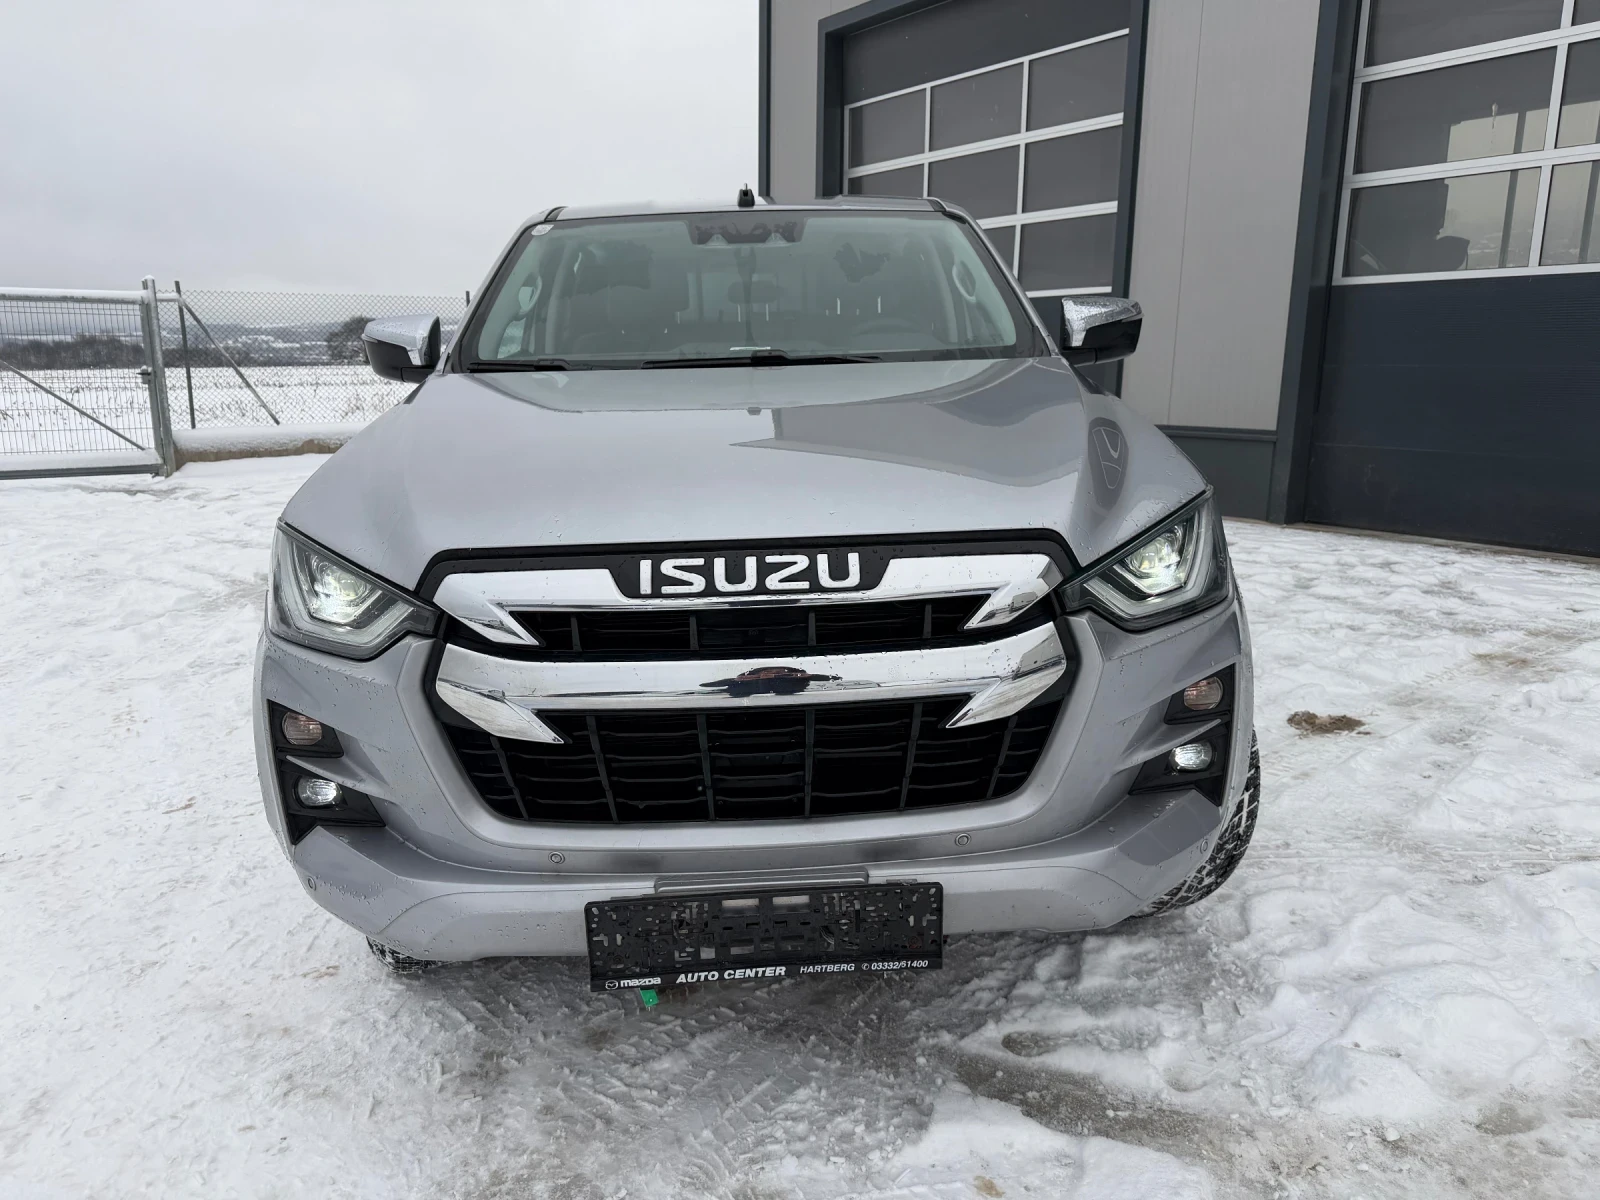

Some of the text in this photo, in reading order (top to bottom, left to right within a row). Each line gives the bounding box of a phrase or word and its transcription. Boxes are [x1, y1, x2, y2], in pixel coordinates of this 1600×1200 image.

[639, 552, 861, 595] ISUZU
[620, 977, 661, 988] mazda
[676, 971, 719, 984] AUTO
[723, 966, 787, 980] CENTER
[799, 963, 855, 974] HARTBERG
